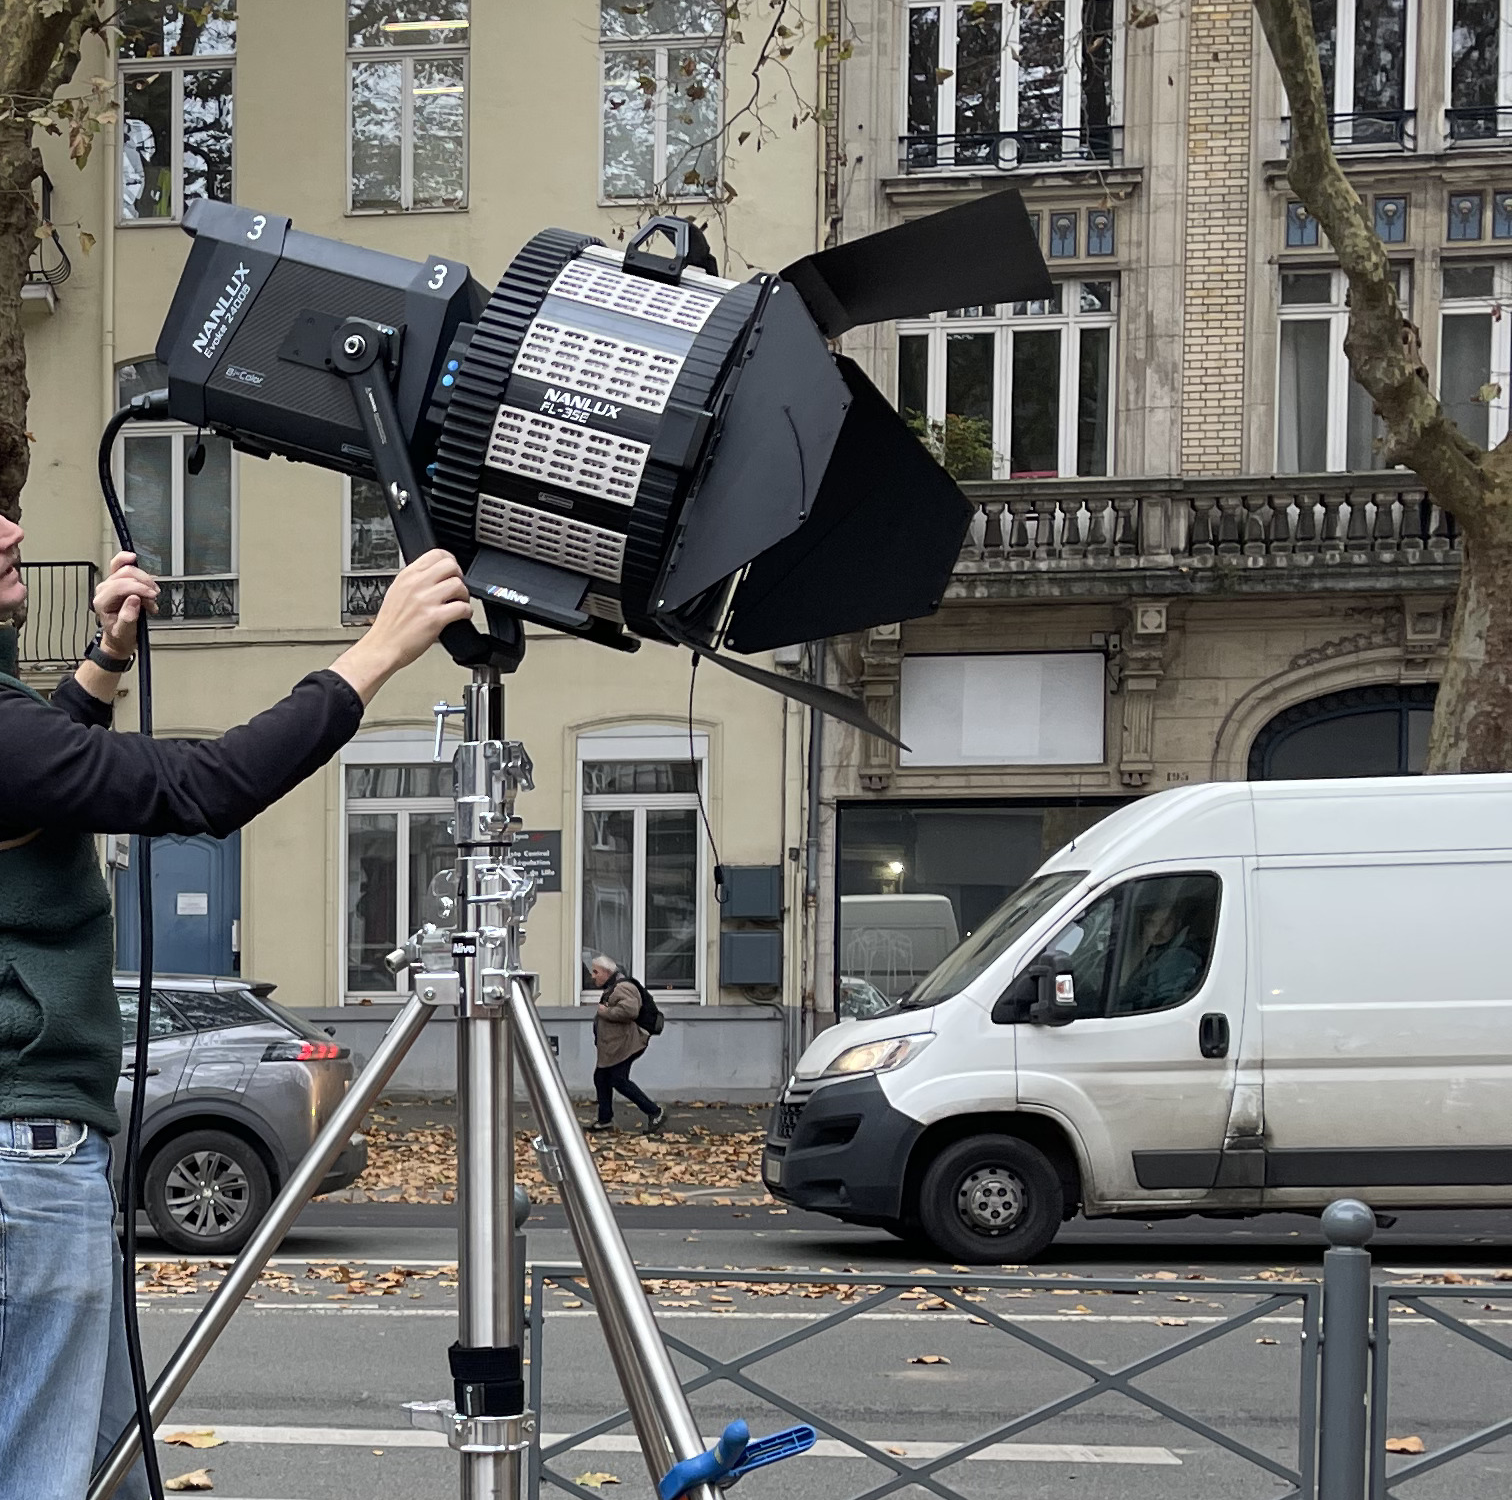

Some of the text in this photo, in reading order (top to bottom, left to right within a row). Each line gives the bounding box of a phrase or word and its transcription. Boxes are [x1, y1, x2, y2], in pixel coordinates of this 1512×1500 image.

[246, 214, 267, 240] 3
[427, 264, 449, 290] 3
[191, 261, 251, 354] NANLUX
[203, 324, 228, 359] Evoke
[539, 401, 591, 424] FL-35E
[543, 387, 623, 420] NANLUX
